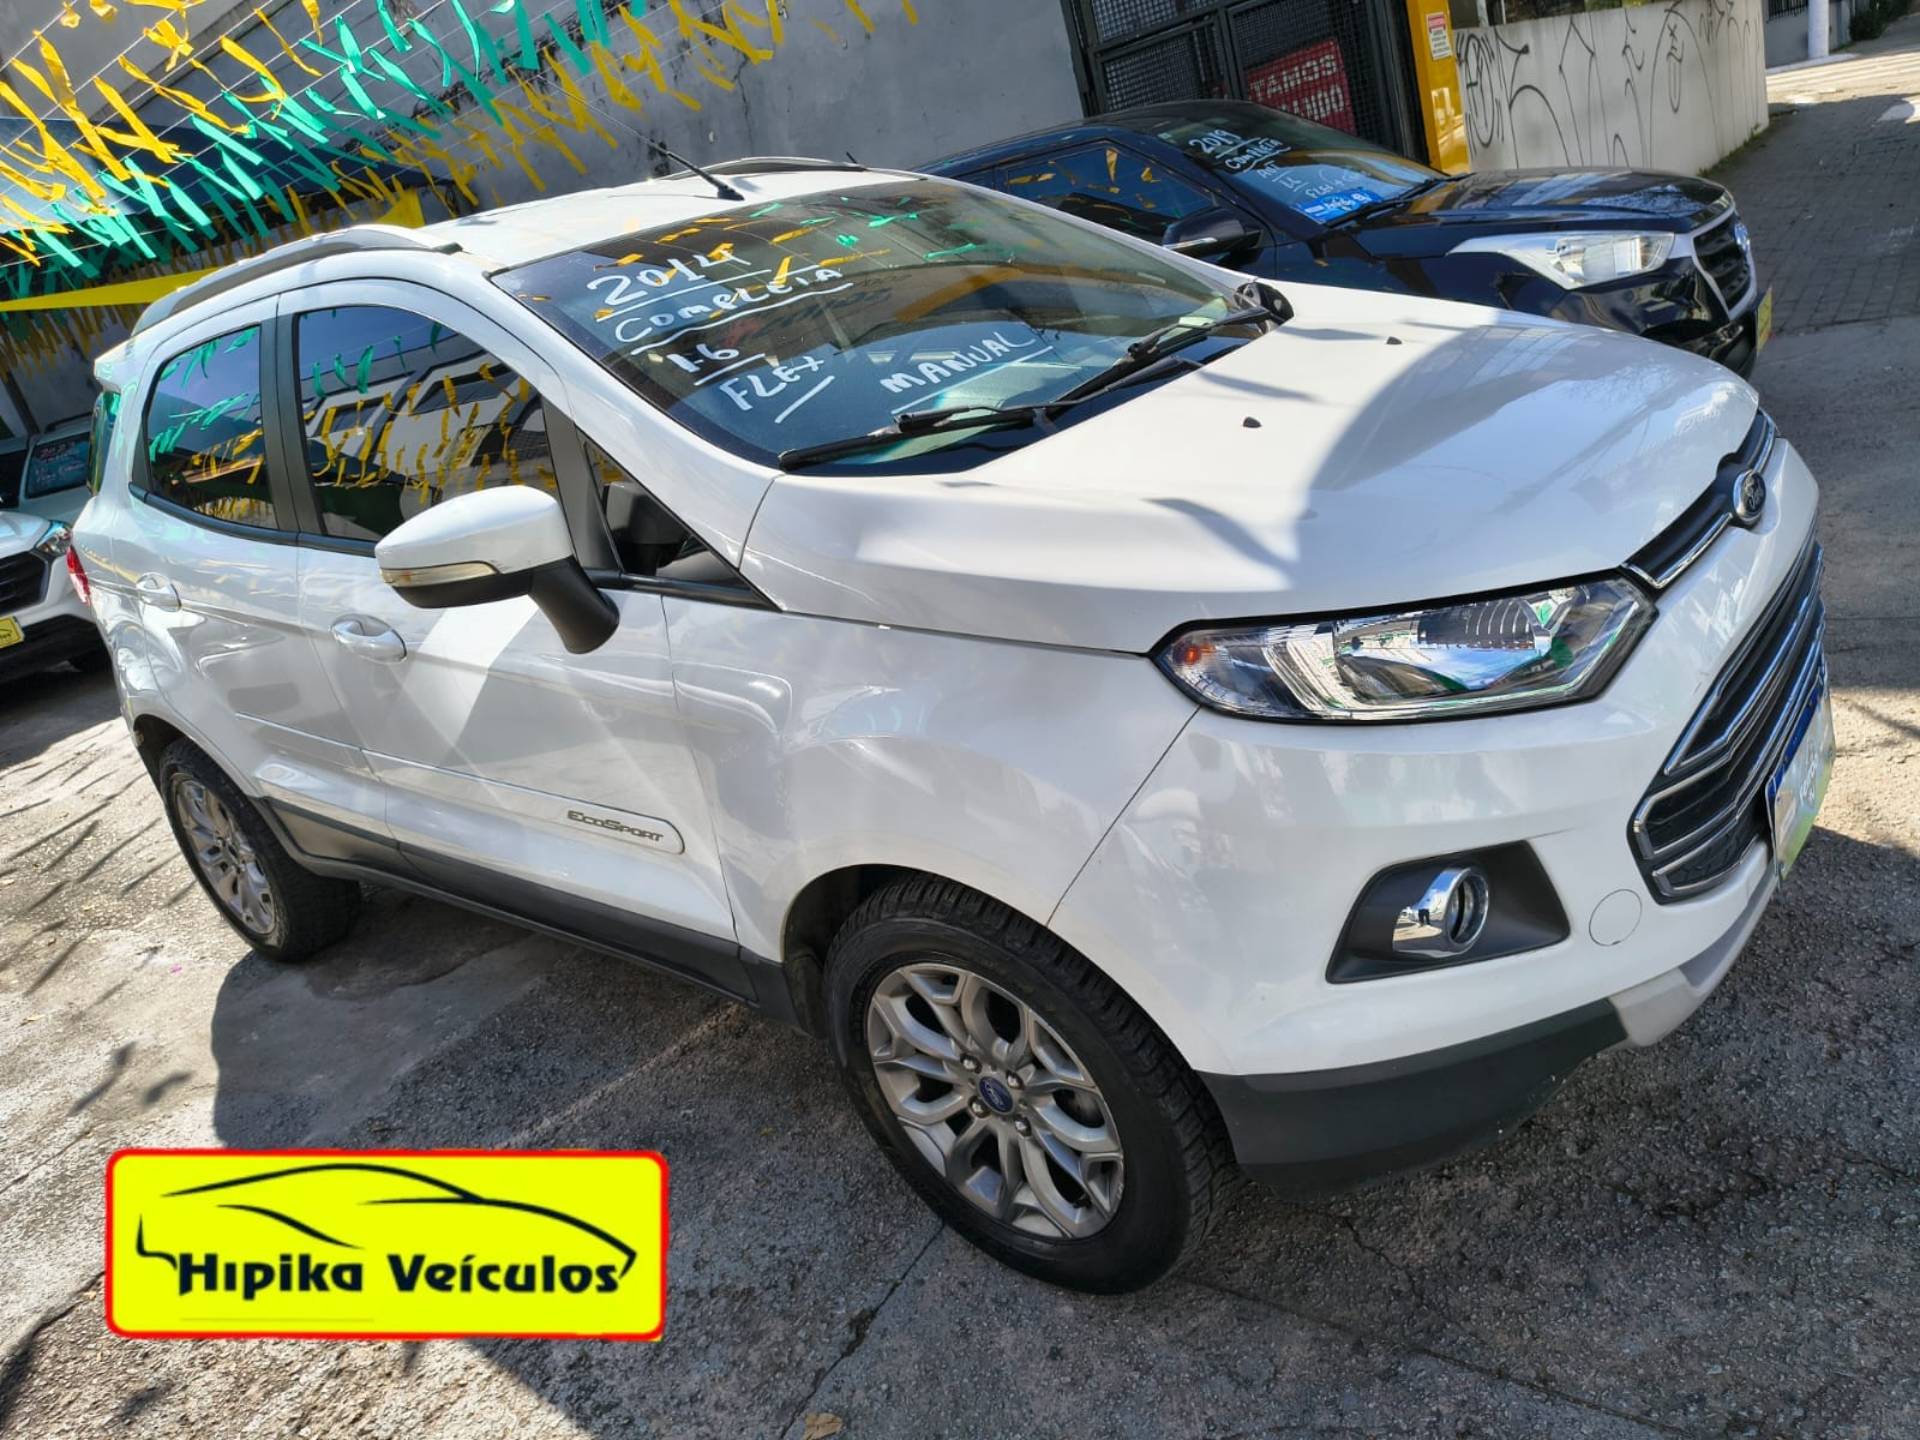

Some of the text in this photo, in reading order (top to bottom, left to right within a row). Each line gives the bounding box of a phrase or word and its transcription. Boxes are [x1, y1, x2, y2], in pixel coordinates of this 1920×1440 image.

[586, 250, 751, 306] 2014
[719, 355, 825, 411] FLEX
[879, 331, 1037, 393] MANUAL
